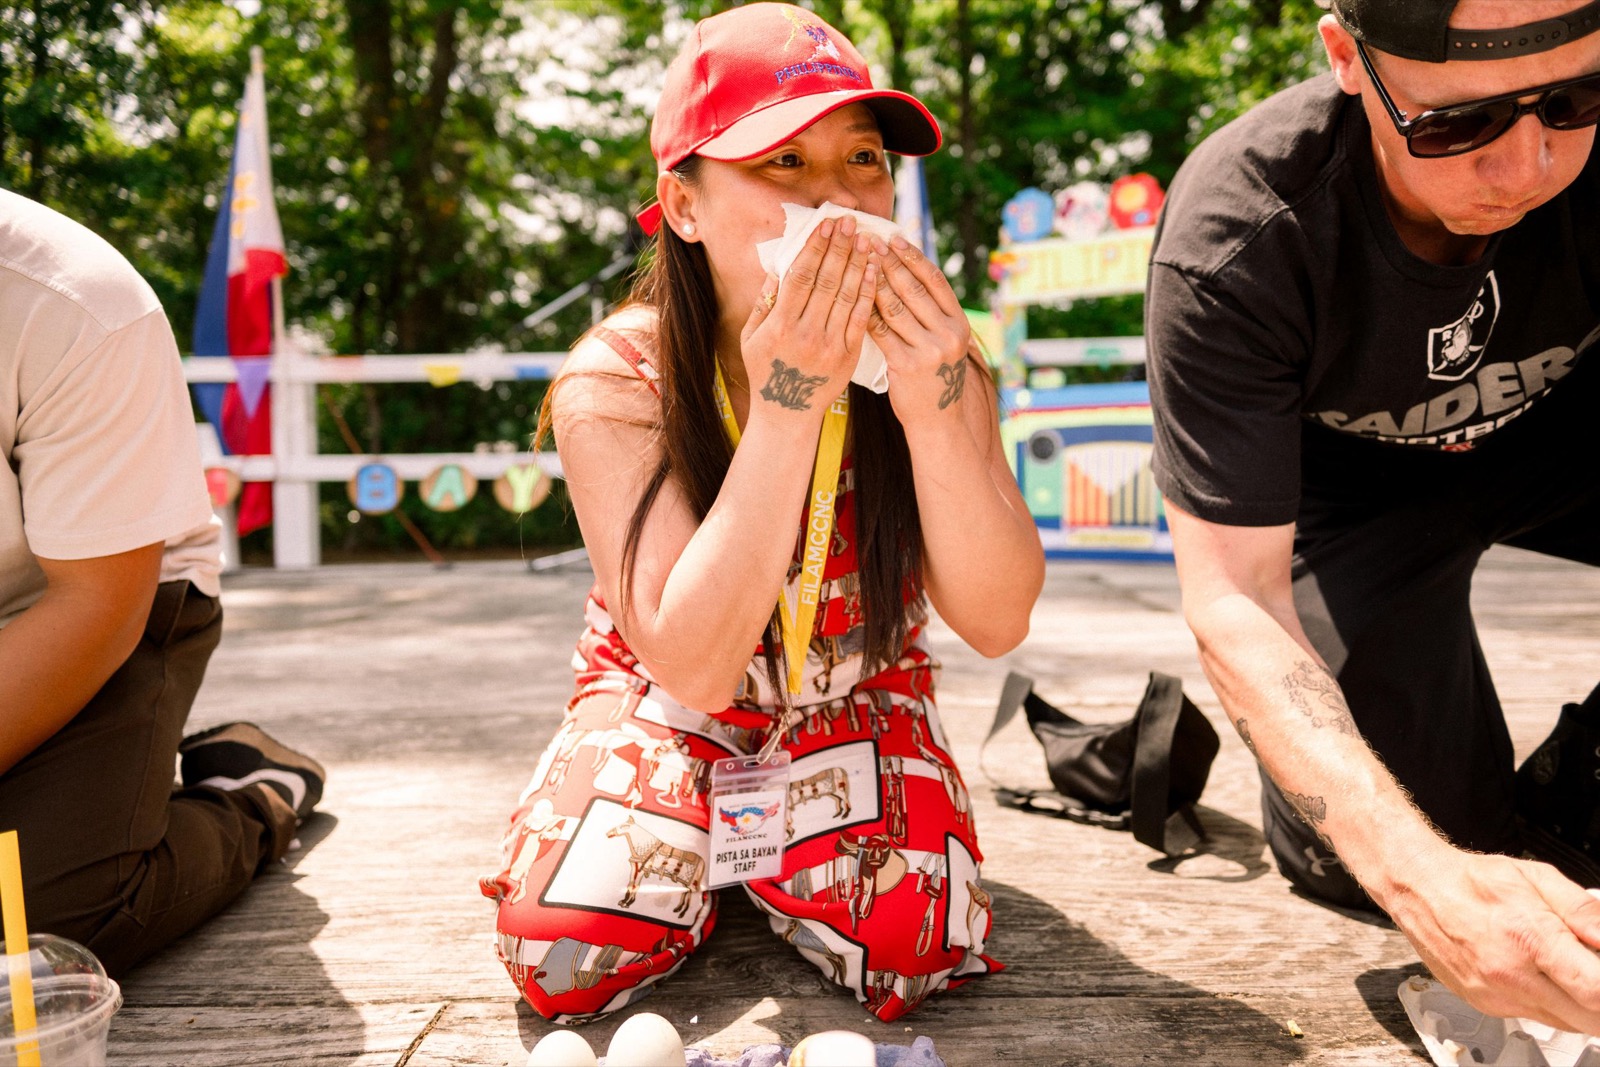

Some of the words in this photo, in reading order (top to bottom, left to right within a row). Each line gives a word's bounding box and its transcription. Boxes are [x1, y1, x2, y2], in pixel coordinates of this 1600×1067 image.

[801, 490, 833, 606] FILAMCCNC
[716, 851, 738, 864] PISTA
[740, 848, 750, 860] SA
[752, 846, 778, 859] BAYAN
[734, 861, 757, 874] STAFF
